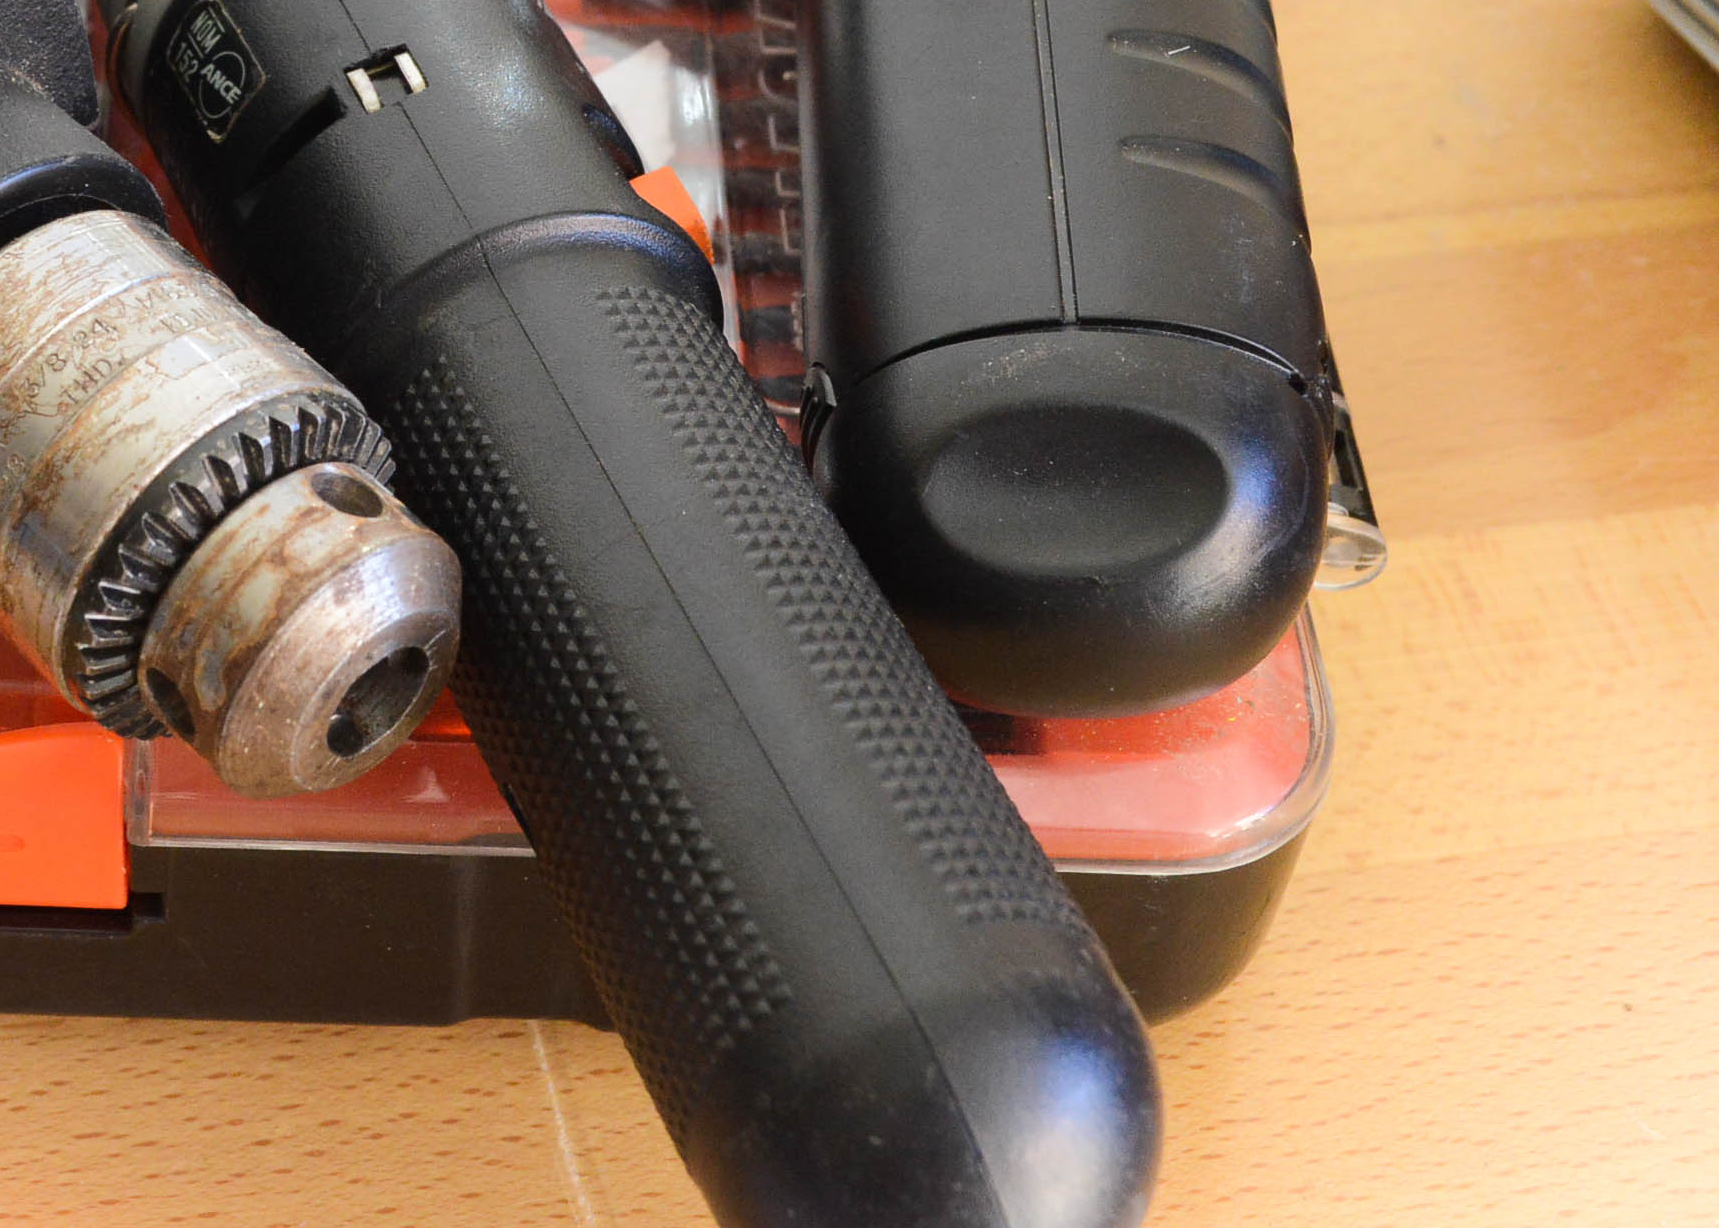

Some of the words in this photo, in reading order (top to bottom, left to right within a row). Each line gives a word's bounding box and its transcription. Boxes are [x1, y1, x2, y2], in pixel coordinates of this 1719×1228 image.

[190, 10, 221, 54] NOM
[175, 41, 199, 83] 152
[200, 63, 241, 104] ANCE
